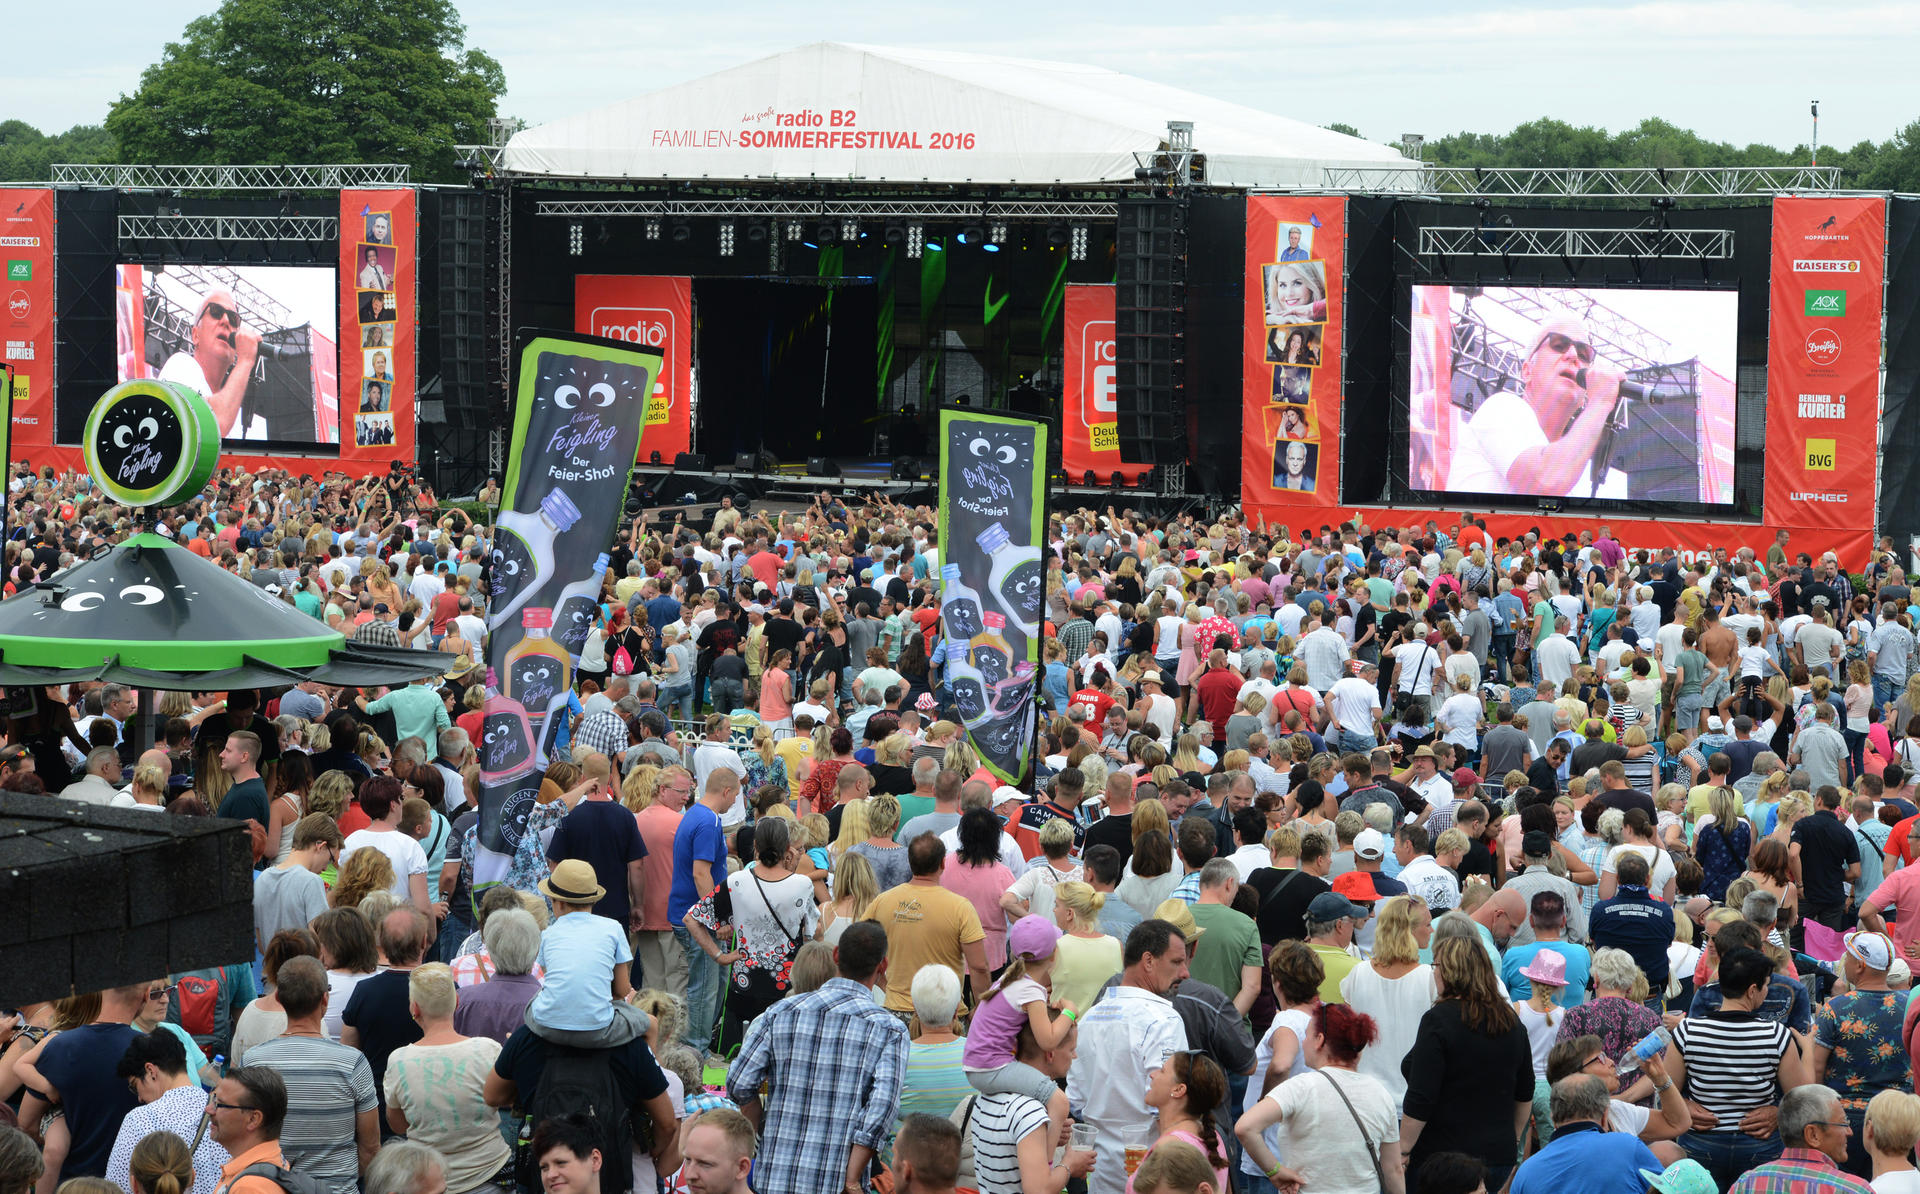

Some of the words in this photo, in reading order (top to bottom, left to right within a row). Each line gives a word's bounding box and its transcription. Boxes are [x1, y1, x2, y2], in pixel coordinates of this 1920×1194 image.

[741, 112, 755, 123] das
[776, 110, 823, 127] radio
[830, 110, 856, 127] B2
[652, 130, 923, 150] FAMILIEN-SOMMERFESTIVAL
[929, 132, 975, 150] 2016
[1, 238, 32, 246] KAISER'S
[12, 264, 28, 274] AOK
[1795, 262, 1847, 271] KAISER'S
[1812, 295, 1840, 308] AOK
[6, 347, 35, 360] KURIER
[1799, 394, 1831, 403] BERLINER
[569, 411, 600, 424] Kleiner
[1798, 403, 1846, 419] KURIER
[546, 419, 618, 459] Feigling
[117, 448, 163, 484] Feigling
[572, 456, 591, 468] Der
[1808, 454, 1832, 467] BVG
[547, 464, 615, 482] Feier-Shot
[1790, 492, 1848, 503] WPHEG
[1076, 694, 1098, 702] TIGERS
[505, 791, 532, 814] AUGEN
[502, 823, 516, 843] BEIM
